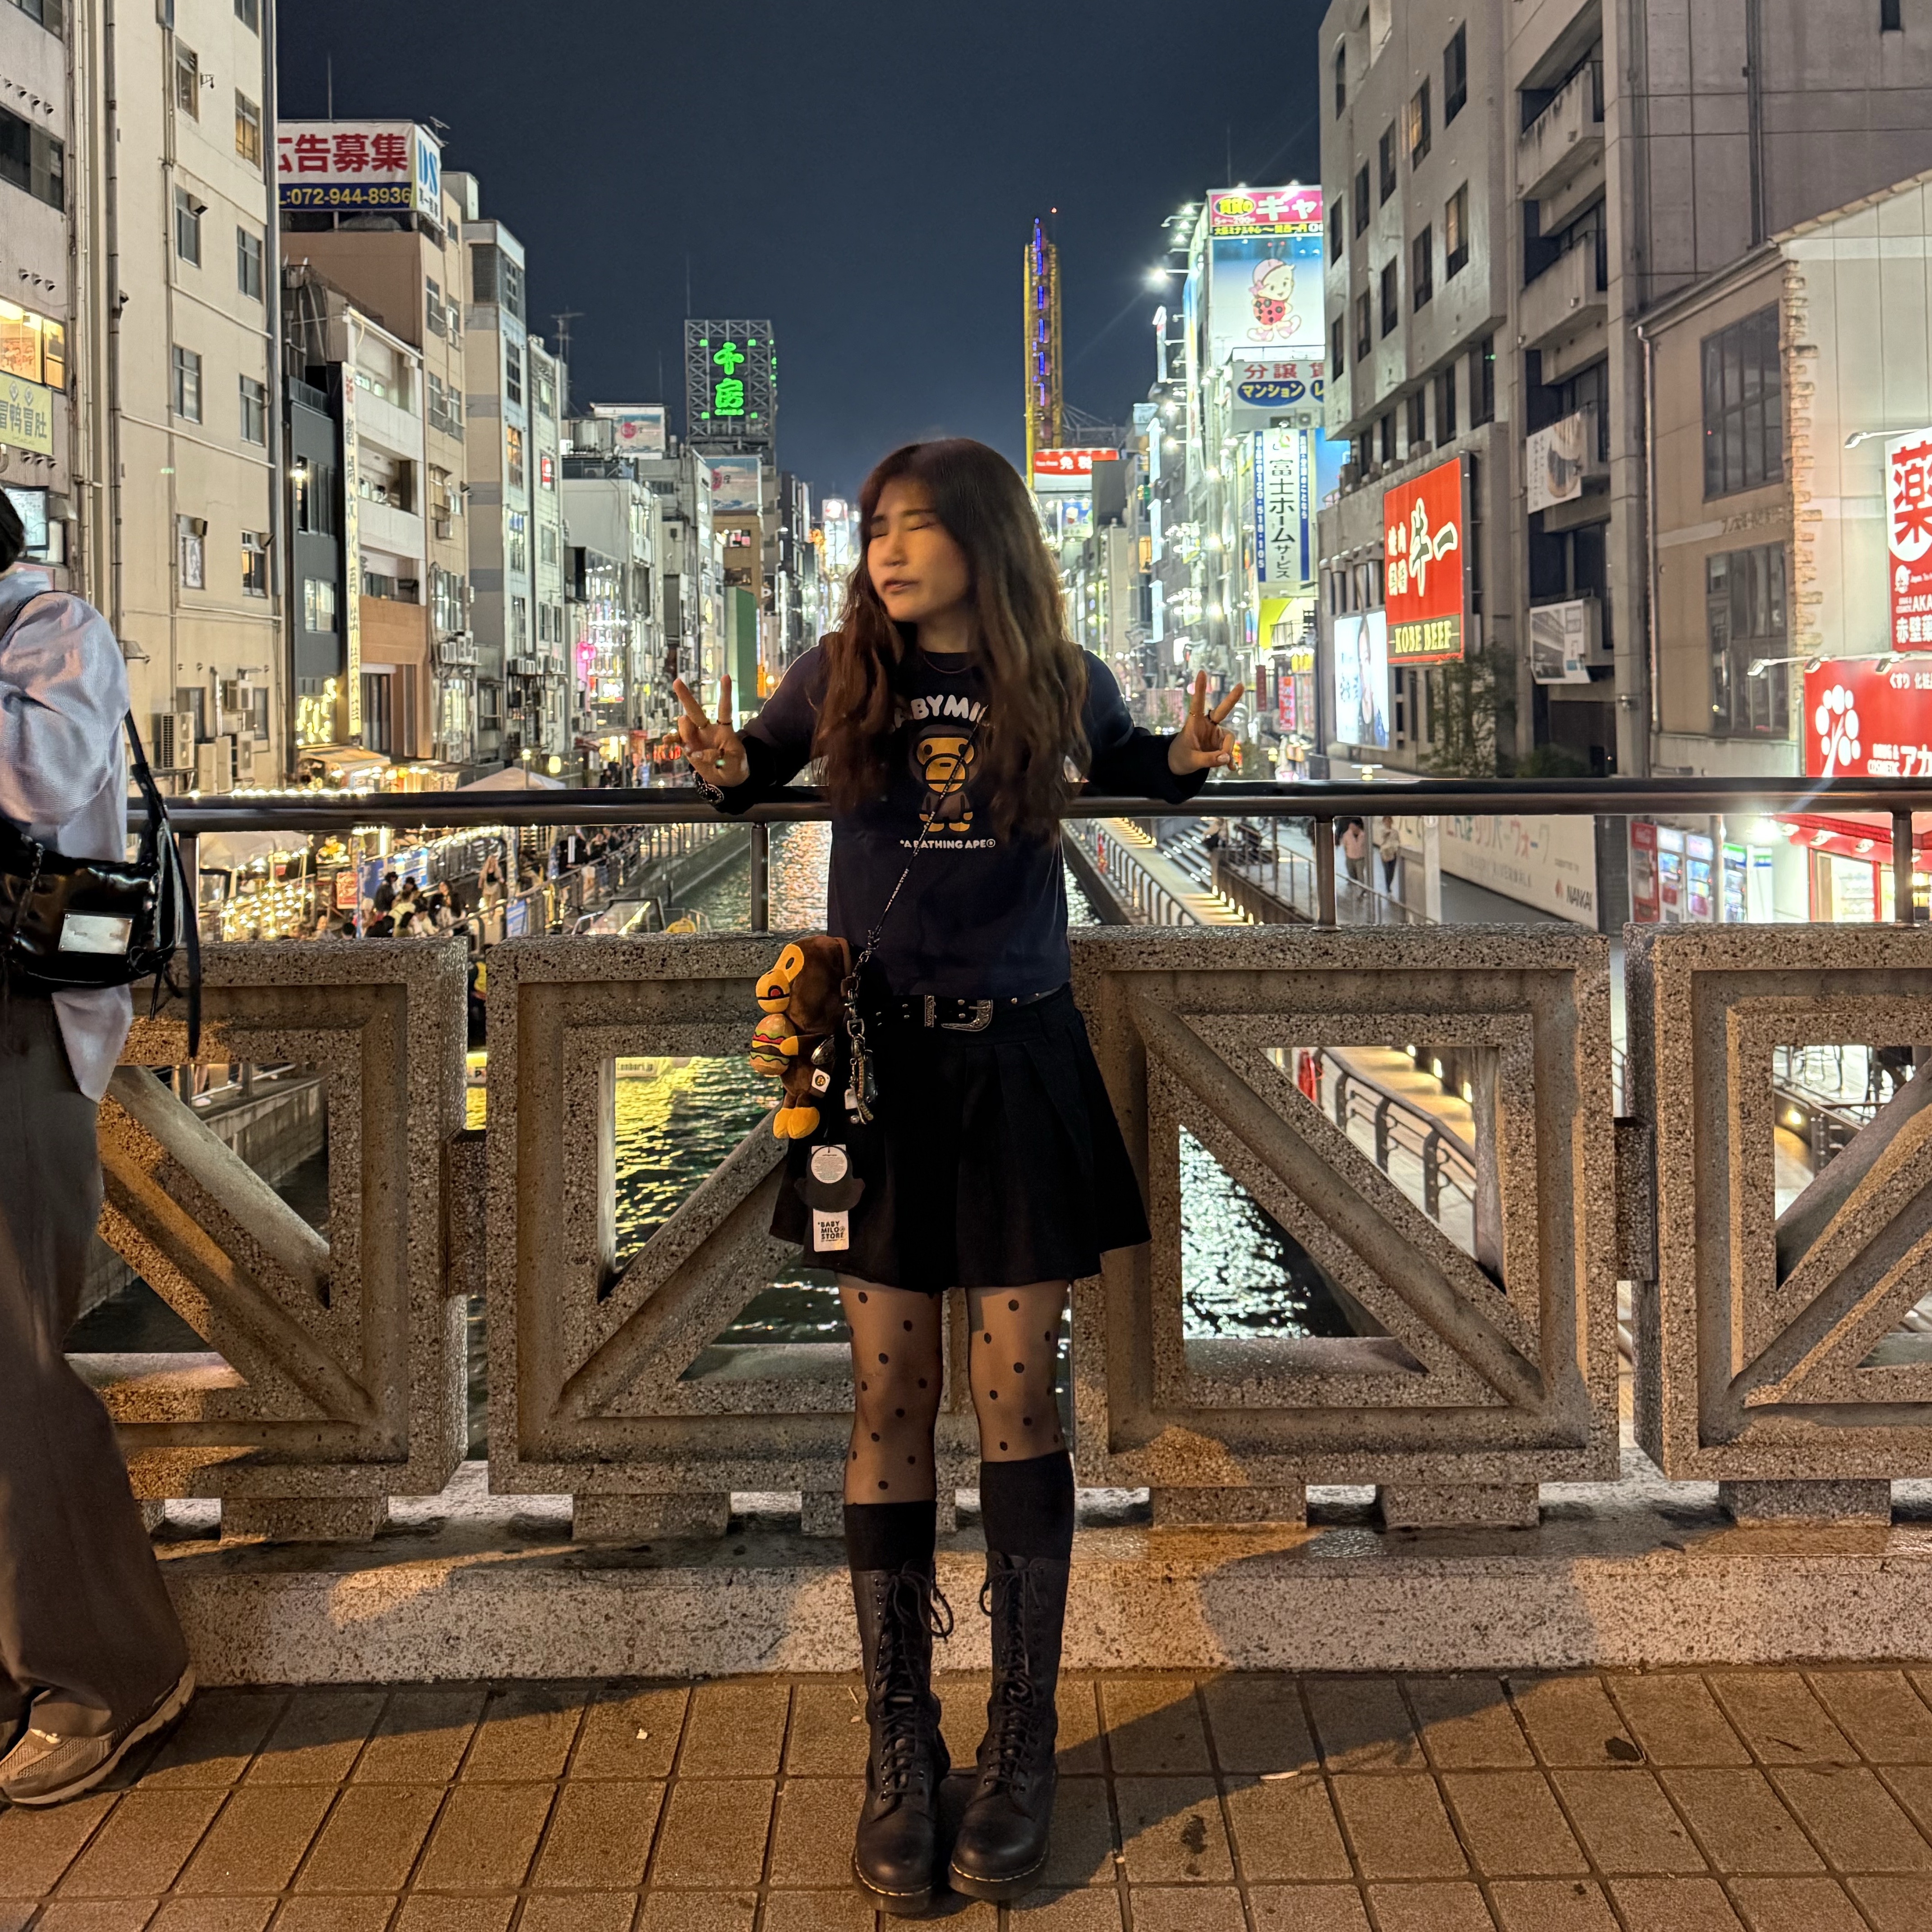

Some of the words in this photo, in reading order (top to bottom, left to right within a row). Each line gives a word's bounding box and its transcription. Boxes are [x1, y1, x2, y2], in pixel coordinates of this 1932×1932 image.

[1244, 363, 1297, 379] 分譲
[1241, 382, 1303, 399] マンション
[1891, 440, 1932, 546] 薬
[1269, 459, 1296, 579] 富士ホームサービス
[1395, 625, 1422, 653] KOBE
[1424, 620, 1452, 651] BEEF
[1914, 672, 1932, 690] 化粧
[892, 694, 987, 729] BYMI
